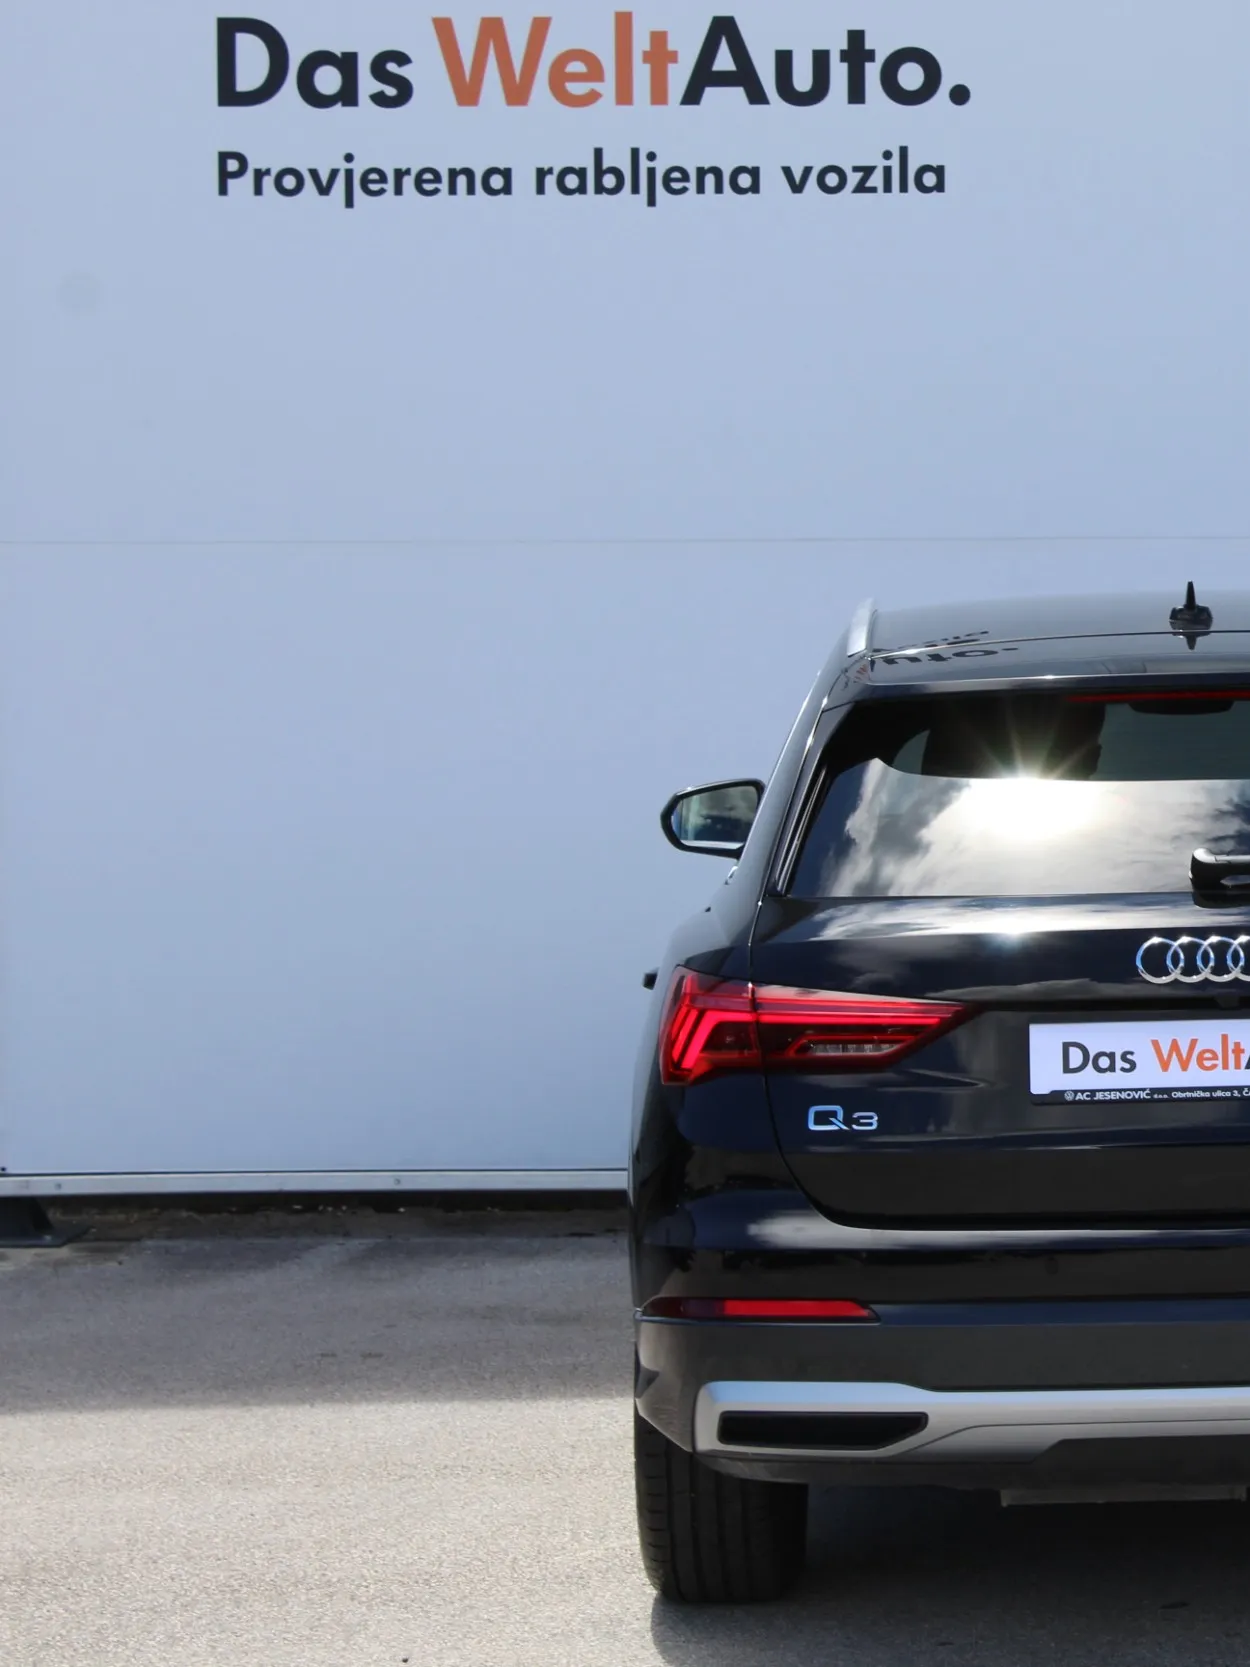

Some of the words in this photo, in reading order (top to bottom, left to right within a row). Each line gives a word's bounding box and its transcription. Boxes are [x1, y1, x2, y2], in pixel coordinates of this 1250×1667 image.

[215, 16, 414, 109] Das
[431, 10, 971, 108] WeltAuto.
[216, 150, 513, 209] Provjerena
[535, 147, 761, 207] rabljena
[780, 145, 947, 194] vozila
[1061, 1041, 1137, 1074] Das
[1075, 1092, 1091, 1100] AC
[1093, 1088, 1151, 1100] JESENOVIĆ
[1171, 1089, 1210, 1099] Obrtnička
[1212, 1089, 1231, 1098] ulica
[808, 1105, 878, 1131] Q3
